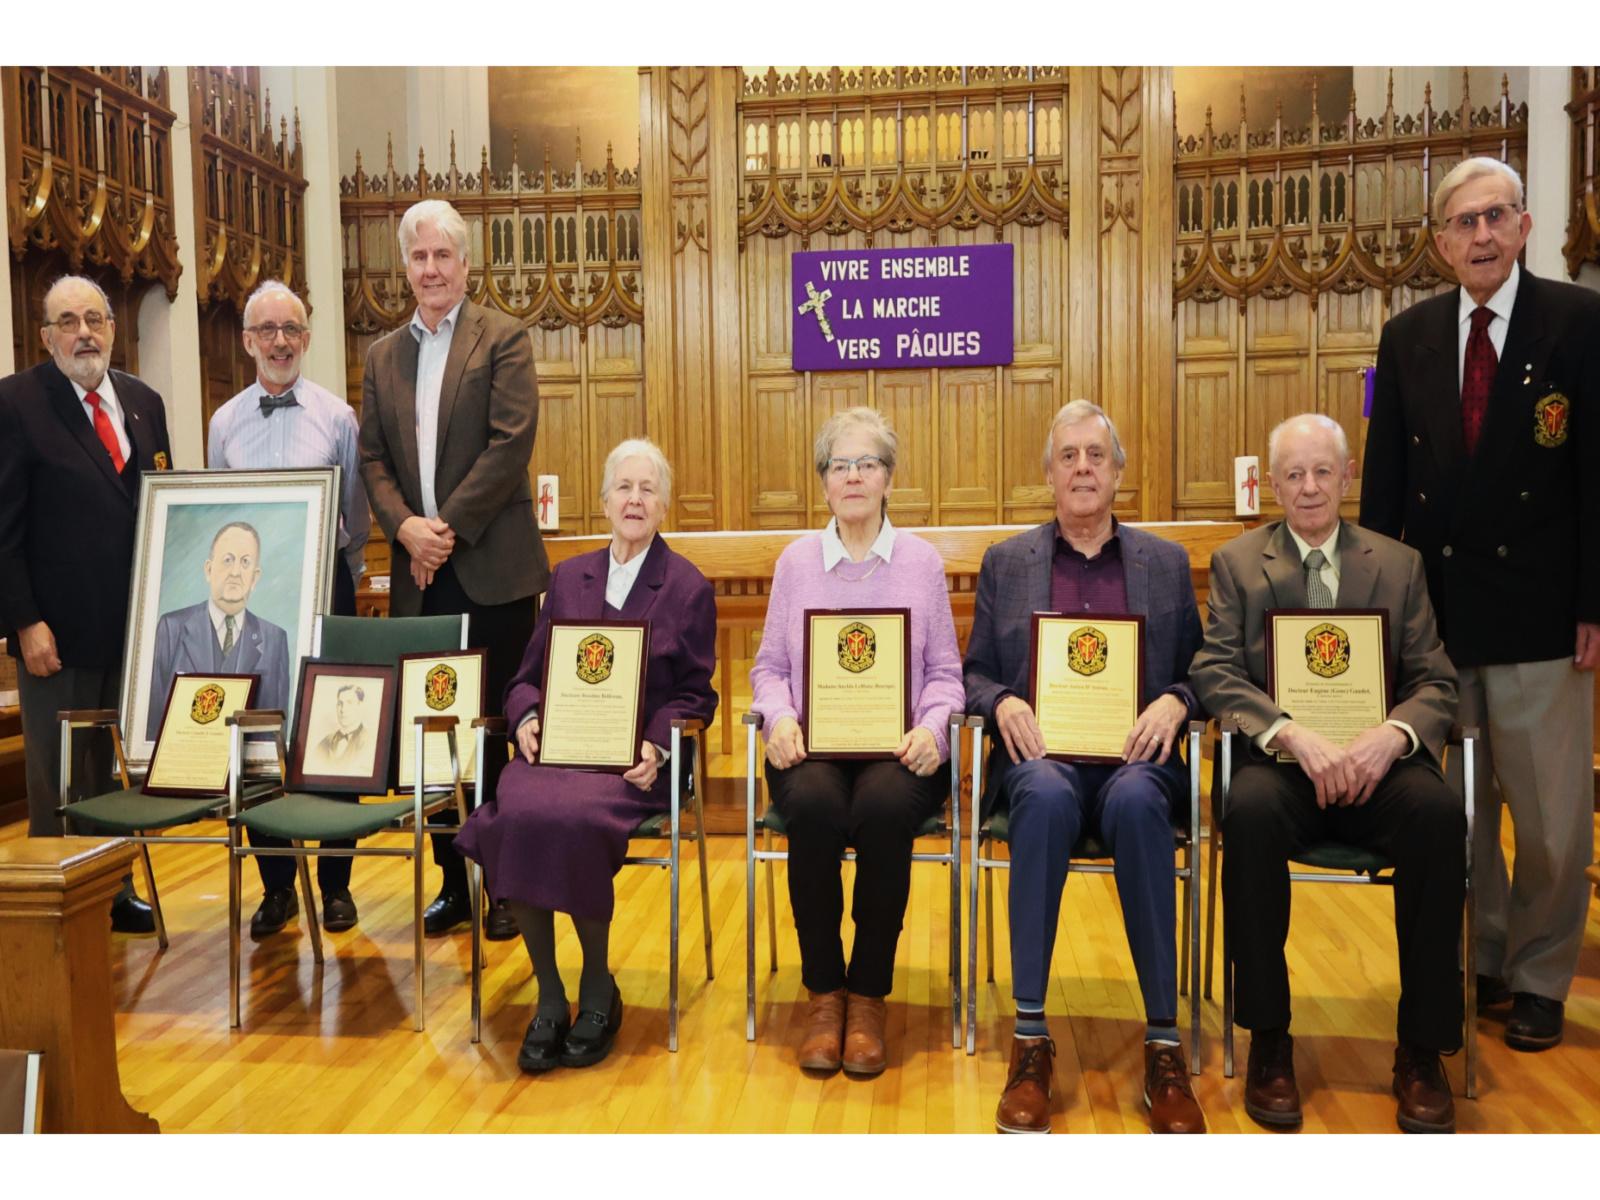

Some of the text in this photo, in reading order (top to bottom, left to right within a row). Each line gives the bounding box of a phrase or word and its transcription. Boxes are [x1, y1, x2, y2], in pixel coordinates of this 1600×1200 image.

[820, 255, 970, 281] VIVRE ENSEMBLE
[842, 296, 941, 319] LA MARCHE
[837, 328, 981, 360] VERS PÂQUES
